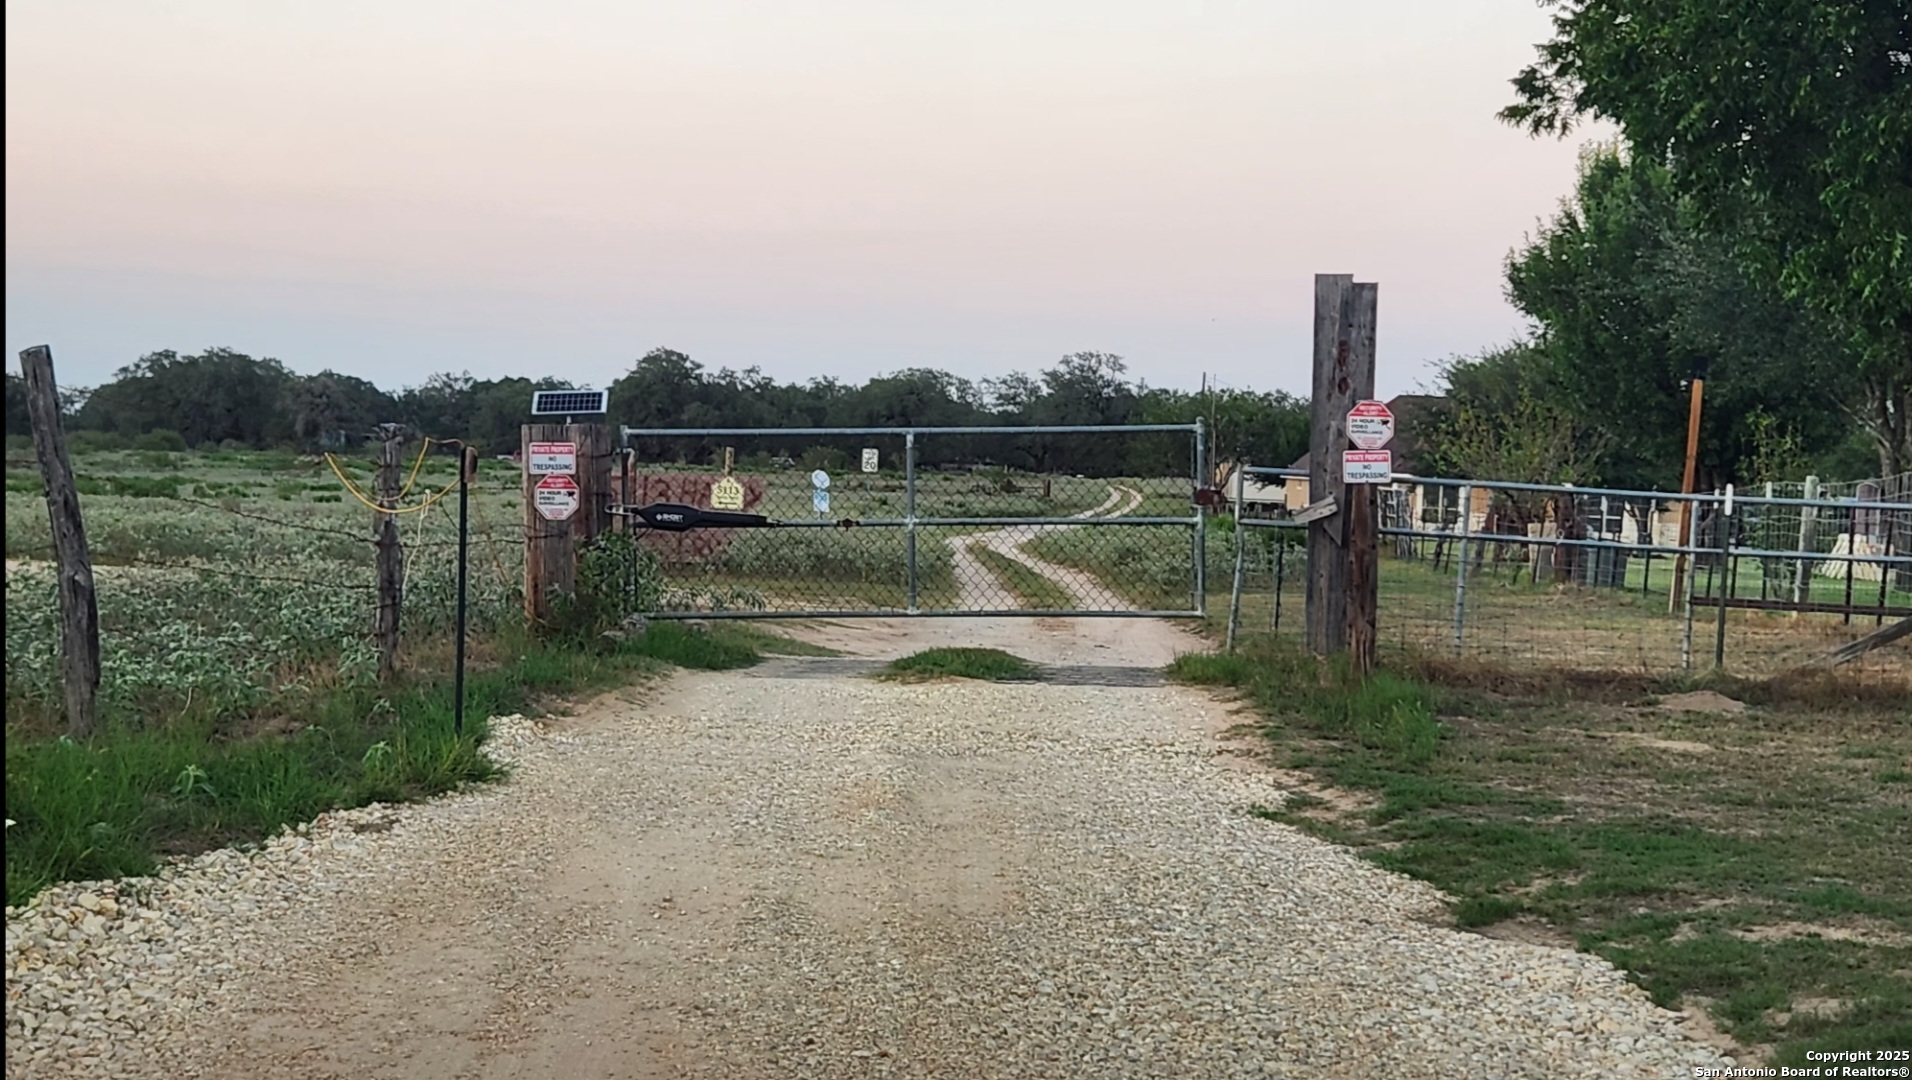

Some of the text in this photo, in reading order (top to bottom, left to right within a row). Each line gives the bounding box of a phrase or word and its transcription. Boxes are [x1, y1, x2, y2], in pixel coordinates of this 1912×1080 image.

[1345, 454, 1388, 462] PRIVATE PROPERTY
[864, 461, 877, 470] 20
